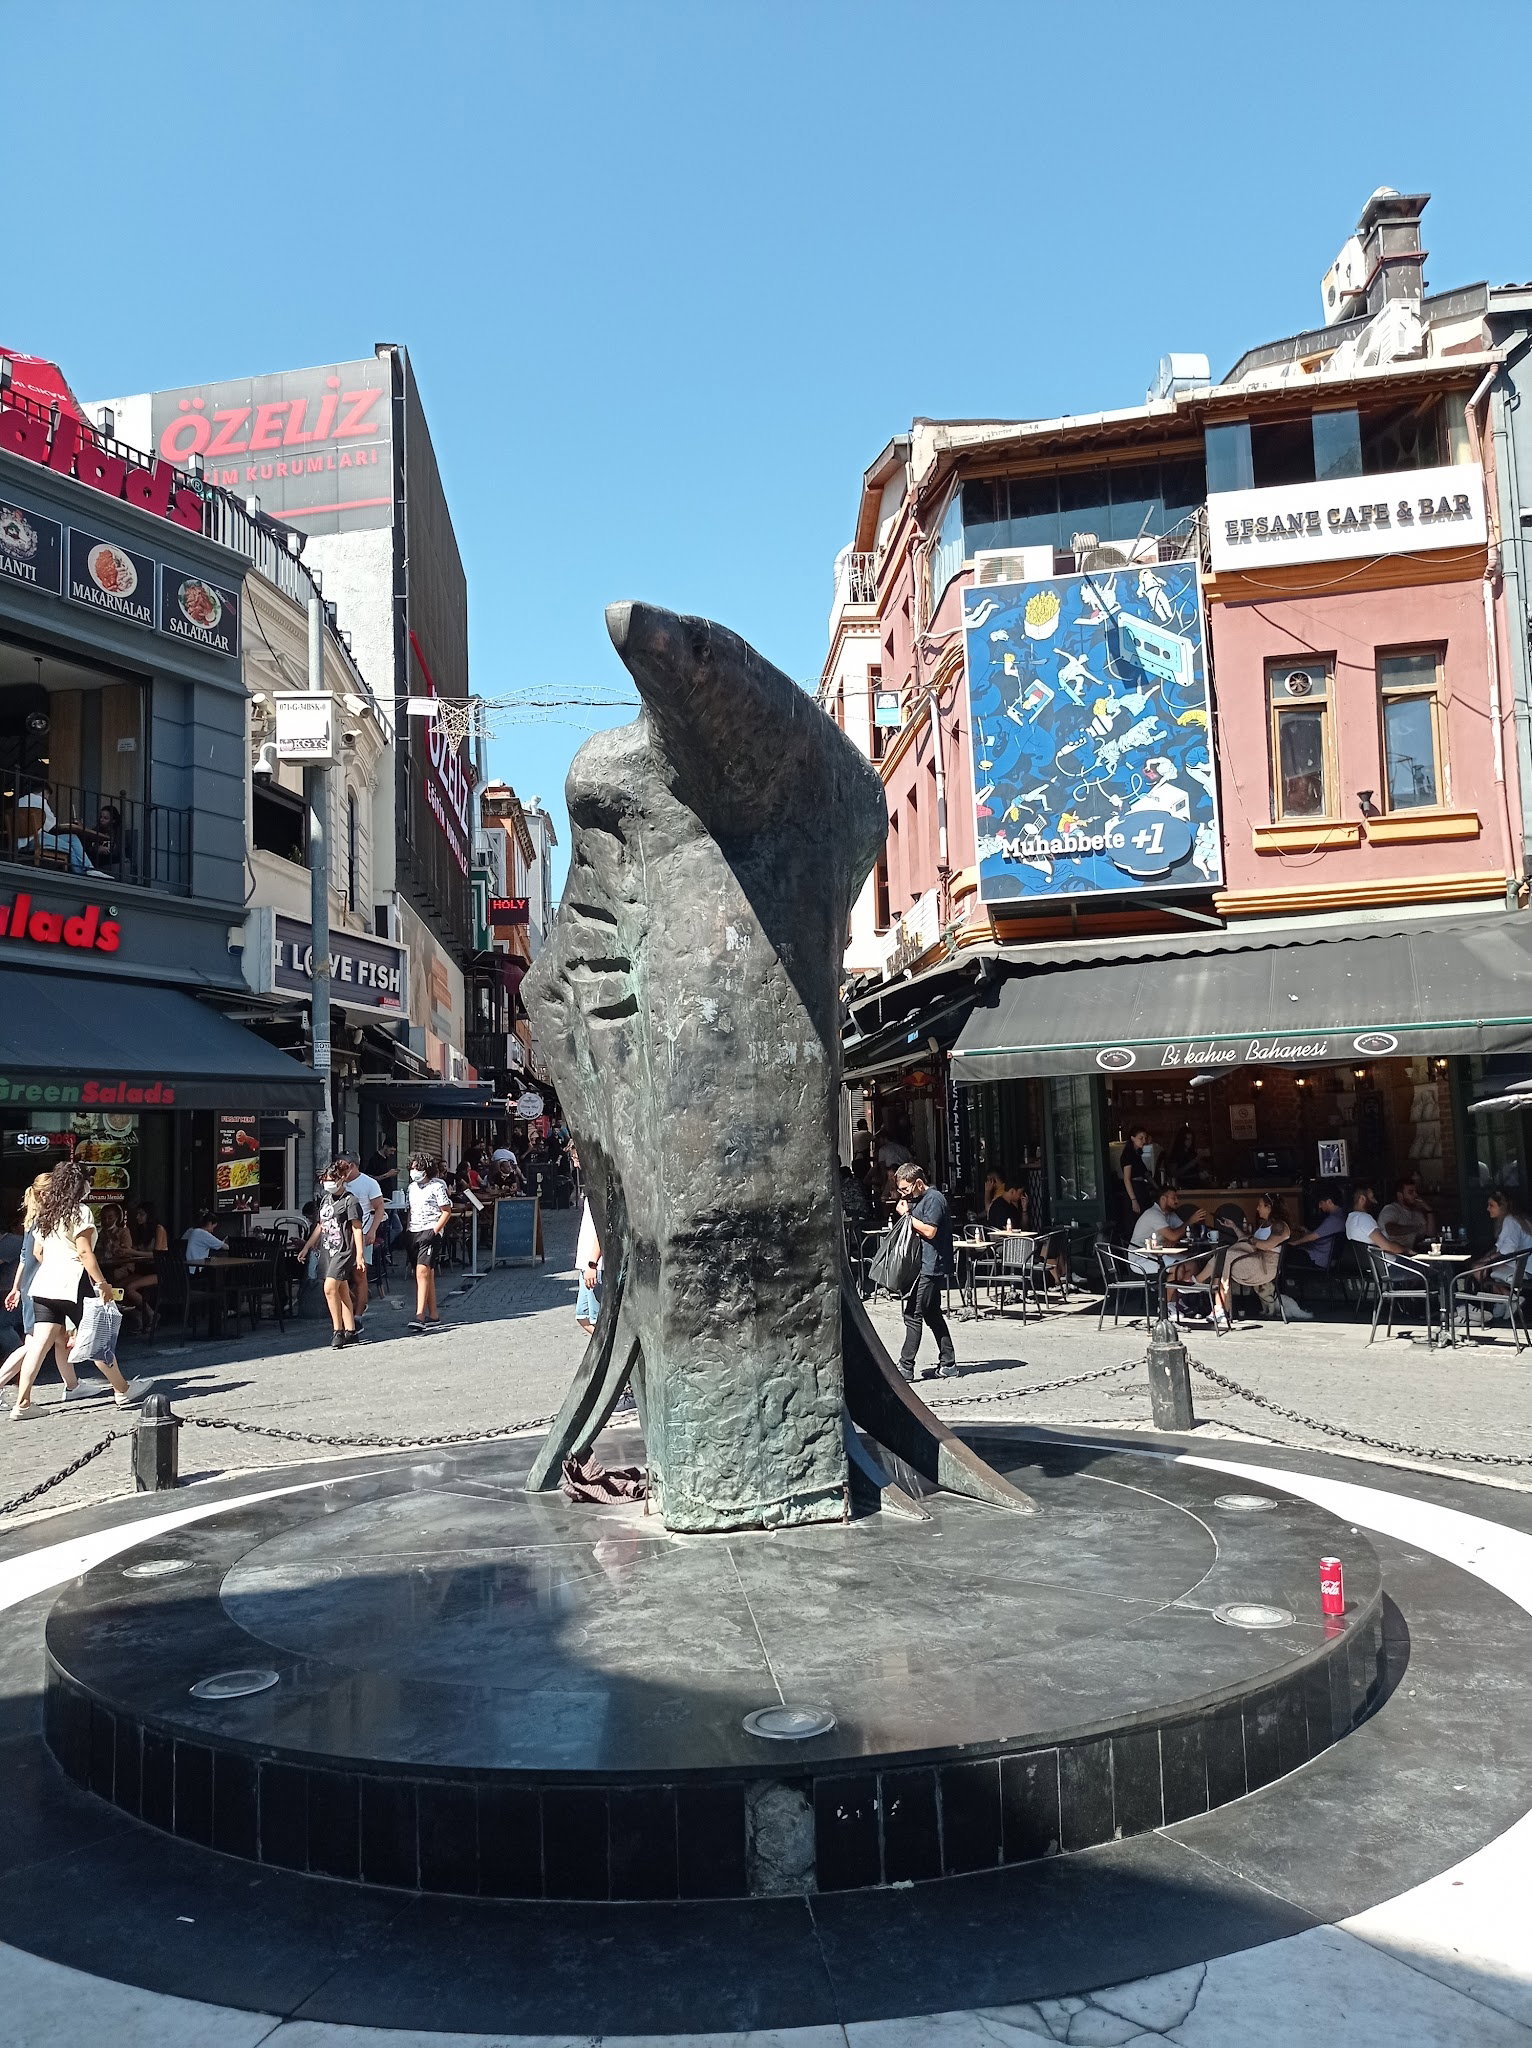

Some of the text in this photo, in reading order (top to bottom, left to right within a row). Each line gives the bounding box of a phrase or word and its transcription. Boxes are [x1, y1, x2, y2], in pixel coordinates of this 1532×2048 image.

[160, 376, 384, 462] ÖZELİZ
[246, 449, 378, 483] KURUMLARI
[1224, 493, 1471, 538] EFSANE CAFE & BAR
[0, 555, 37, 582] ANTI
[72, 581, 152, 623] MAKARNALAR
[169, 617, 230, 651] SALATALAR
[293, 739, 327, 748] KGYS
[1000, 822, 1165, 858] Muhabbete +1
[493, 899, 526, 909] HOLY
[357, 960, 400, 993] FISH
[1161, 1038, 1328, 1067] Bi kahve Bahanesi
[17, 1133, 47, 1145] Since
